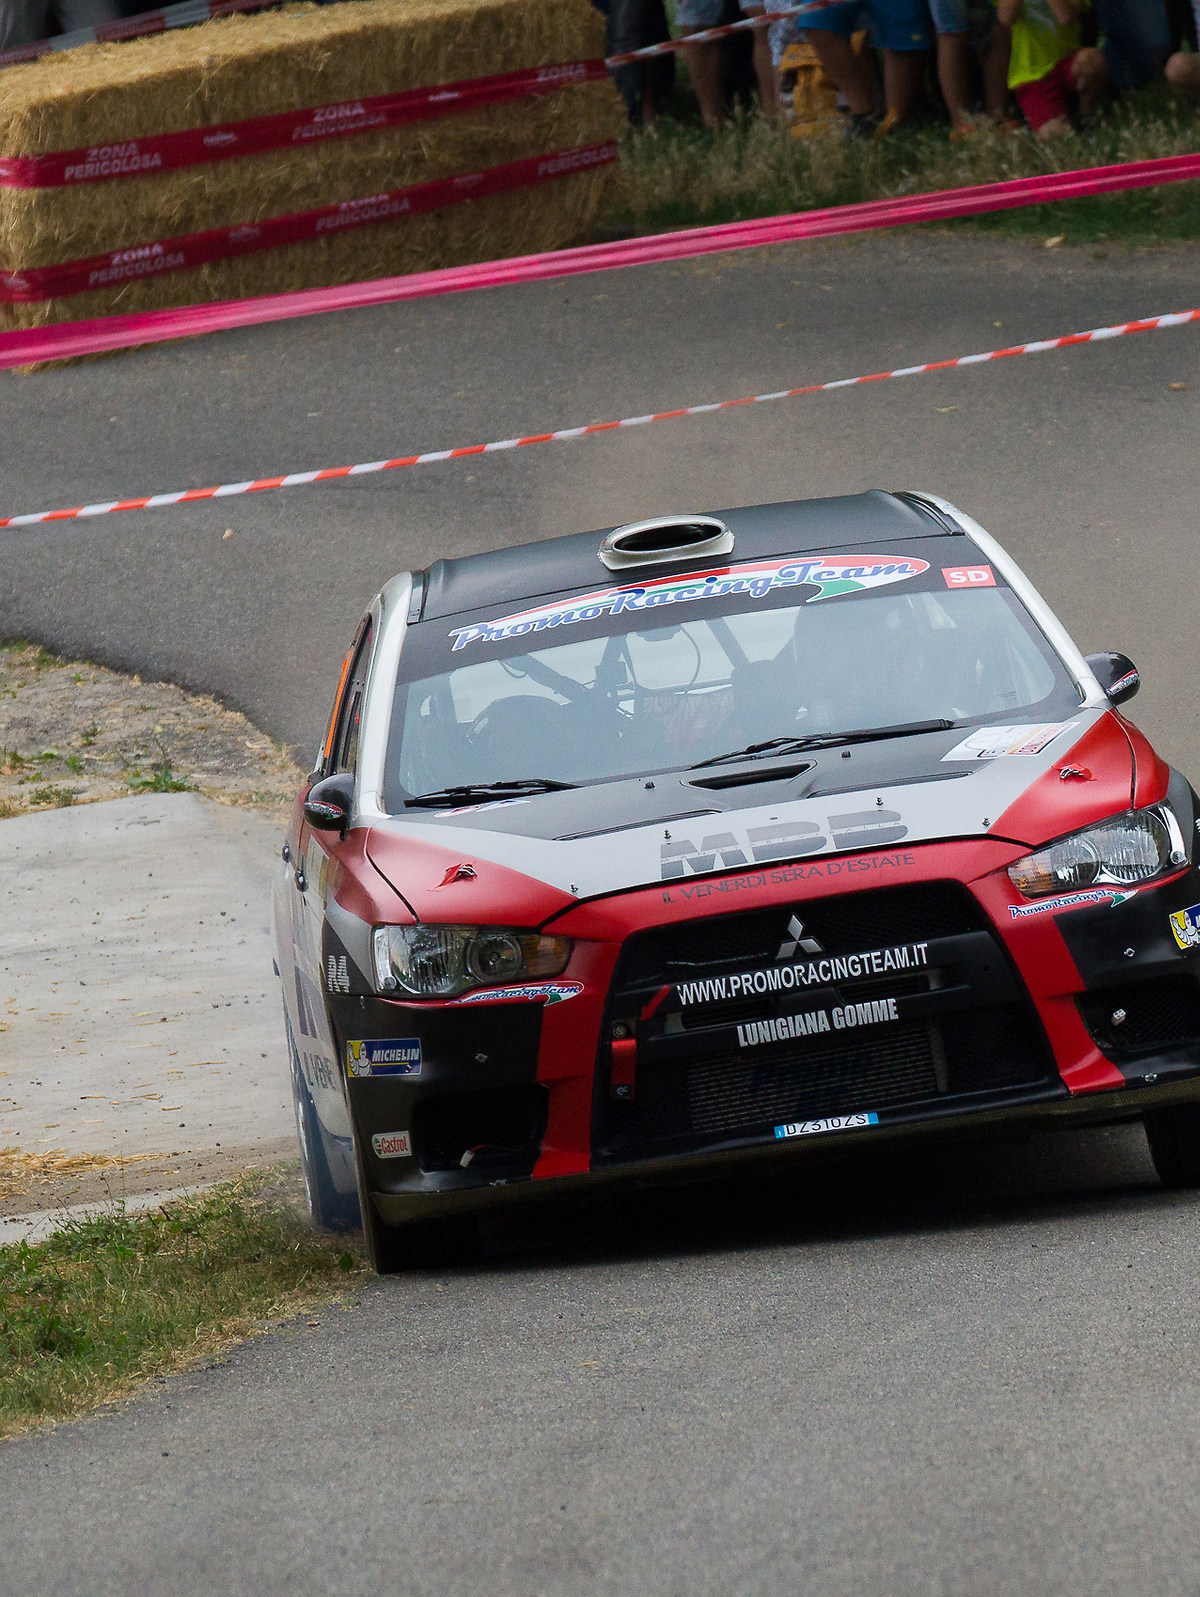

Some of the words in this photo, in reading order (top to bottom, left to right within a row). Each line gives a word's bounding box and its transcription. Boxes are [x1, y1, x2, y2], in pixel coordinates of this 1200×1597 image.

[313, 102, 365, 122] ZONA
[292, 113, 388, 140] PERICOLOSA
[87, 142, 139, 162] ZONA
[64, 152, 162, 181] PERICOLOSA
[315, 197, 411, 231] PERICOLOSA
[111, 243, 163, 265] ZONA
[88, 251, 185, 285] PERICOLOSA
[950, 568, 989, 585] SD
[662, 891, 677, 905] IL
[680, 870, 767, 900] VENERDÌ
[770, 865, 824, 885] SERA
[827, 853, 916, 876] D'ESTATE
[677, 942, 929, 1006] WWW.PROMORACINGTEAM.IT
[737, 1010, 831, 1047] LUNIGIANA
[832, 998, 899, 1031] GOMME
[372, 1047, 420, 1062] MICHELIN
[381, 1136, 408, 1154] Castrol
